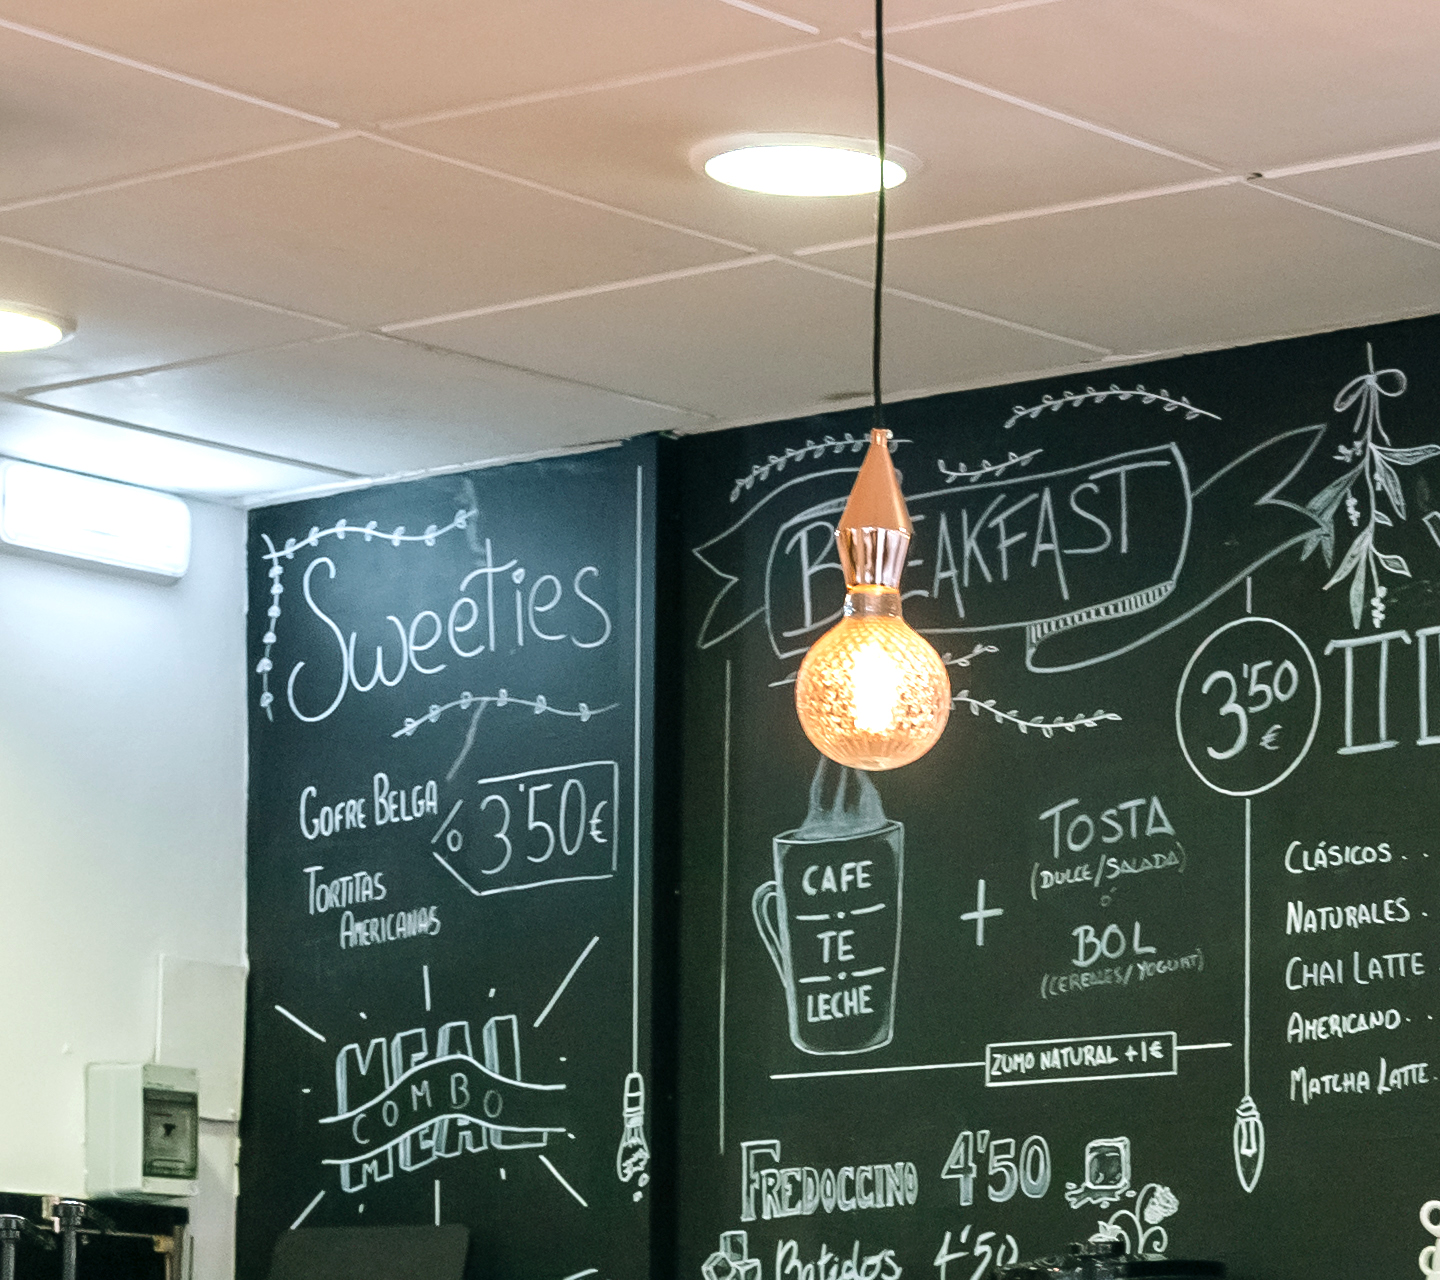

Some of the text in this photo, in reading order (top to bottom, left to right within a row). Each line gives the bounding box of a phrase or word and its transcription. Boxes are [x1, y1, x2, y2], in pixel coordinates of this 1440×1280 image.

[288, 538, 611, 723] Sweeties
[299, 772, 438, 840] GOFRE BELGA
[1038, 795, 1177, 859] TOSTA
[801, 860, 874, 896] CAFE
[1284, 840, 1394, 874] CLÁSICOS
[302, 864, 387, 915] TORTITAS
[338, 904, 441, 949] AMERICANAS
[1285, 897, 1411, 935] NATURALES
[816, 929, 856, 965] TE
[1071, 920, 1158, 968] BOL
[1284, 955, 1344, 991] CHAI
[1353, 951, 1426, 985] LATTE
[806, 984, 875, 1024] LECHE
[1286, 1008, 1402, 1044] AMERICANO
[990, 1050, 1035, 1077] ZUMO
[1039, 1043, 1119, 1072] NATURAL
[1289, 1065, 1371, 1105] MATCHA
[1377, 1056, 1430, 1096] LATTE
[351, 1071, 503, 1145] COMBO
[739, 1139, 920, 1222] FREDOCCINO
